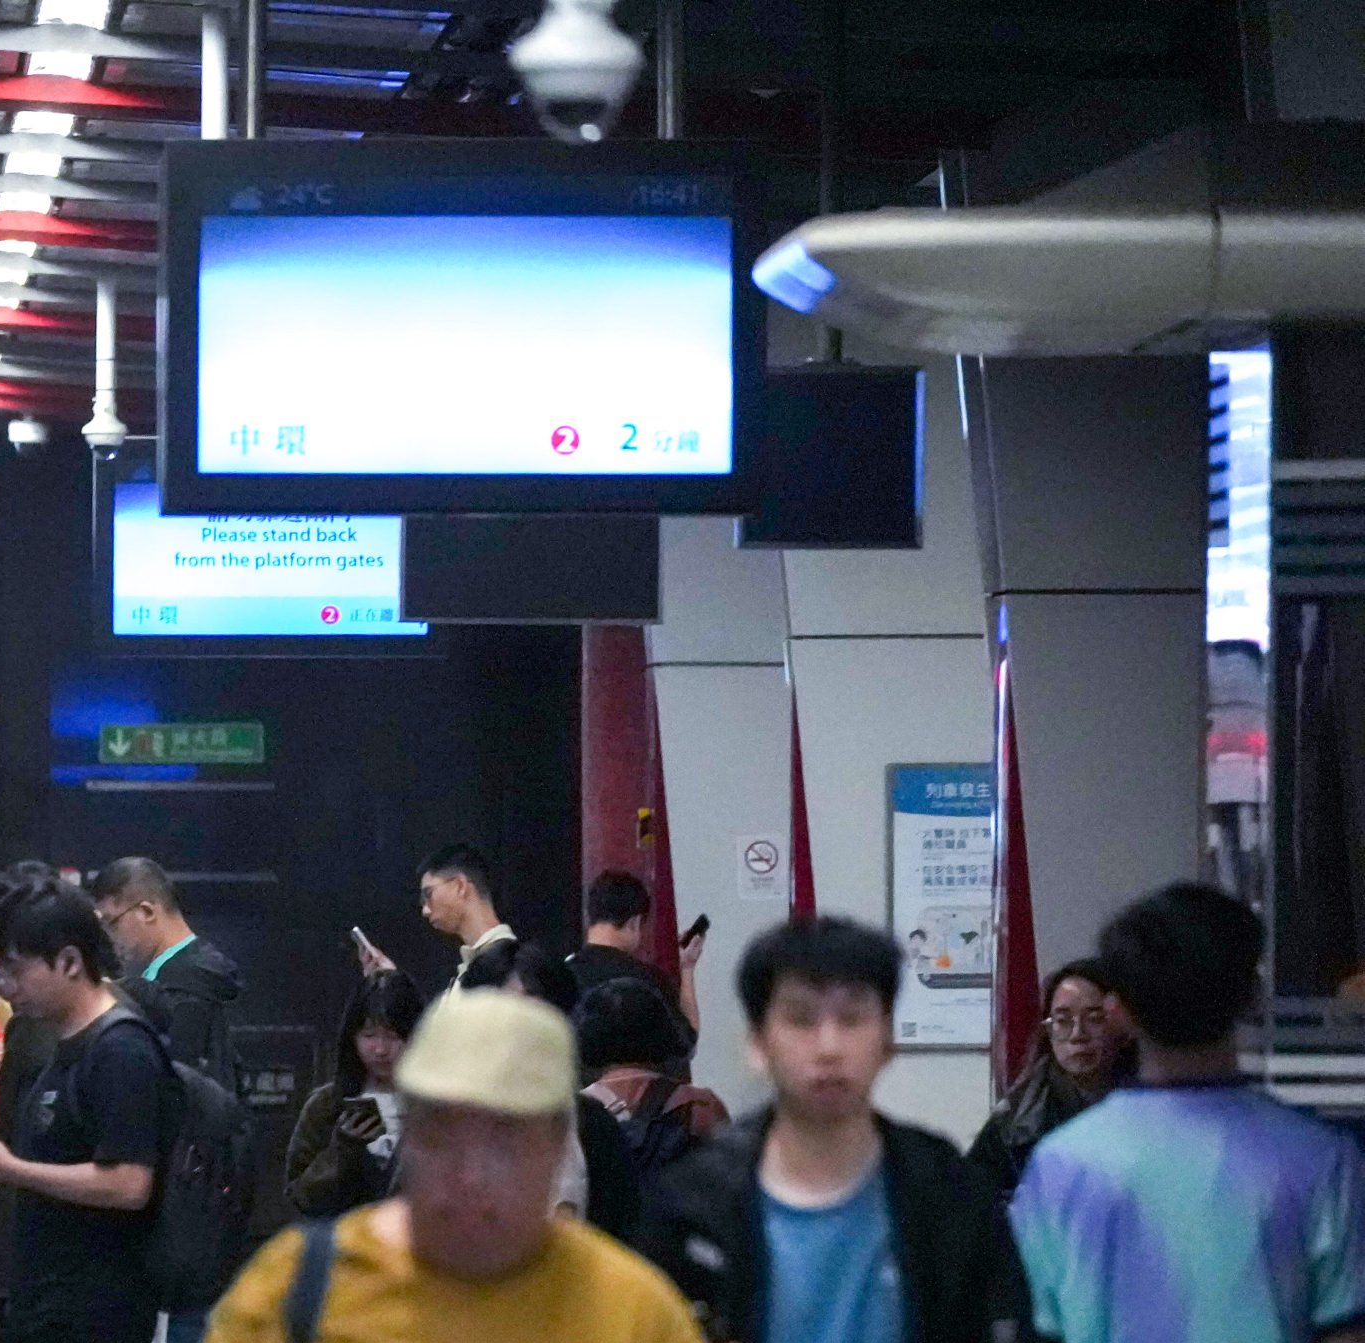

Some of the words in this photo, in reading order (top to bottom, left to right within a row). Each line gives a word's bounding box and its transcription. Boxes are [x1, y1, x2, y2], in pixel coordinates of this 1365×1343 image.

[553, 426, 579, 454] 2
[620, 423, 639, 451] 2
[201, 527, 258, 543] Please
[262, 527, 311, 543] stand
[317, 527, 357, 543] back
[174, 552, 216, 568] from
[221, 552, 250, 568] the
[255, 552, 331, 571] platform
[336, 553, 384, 572] gates
[321, 606, 339, 623] 2
